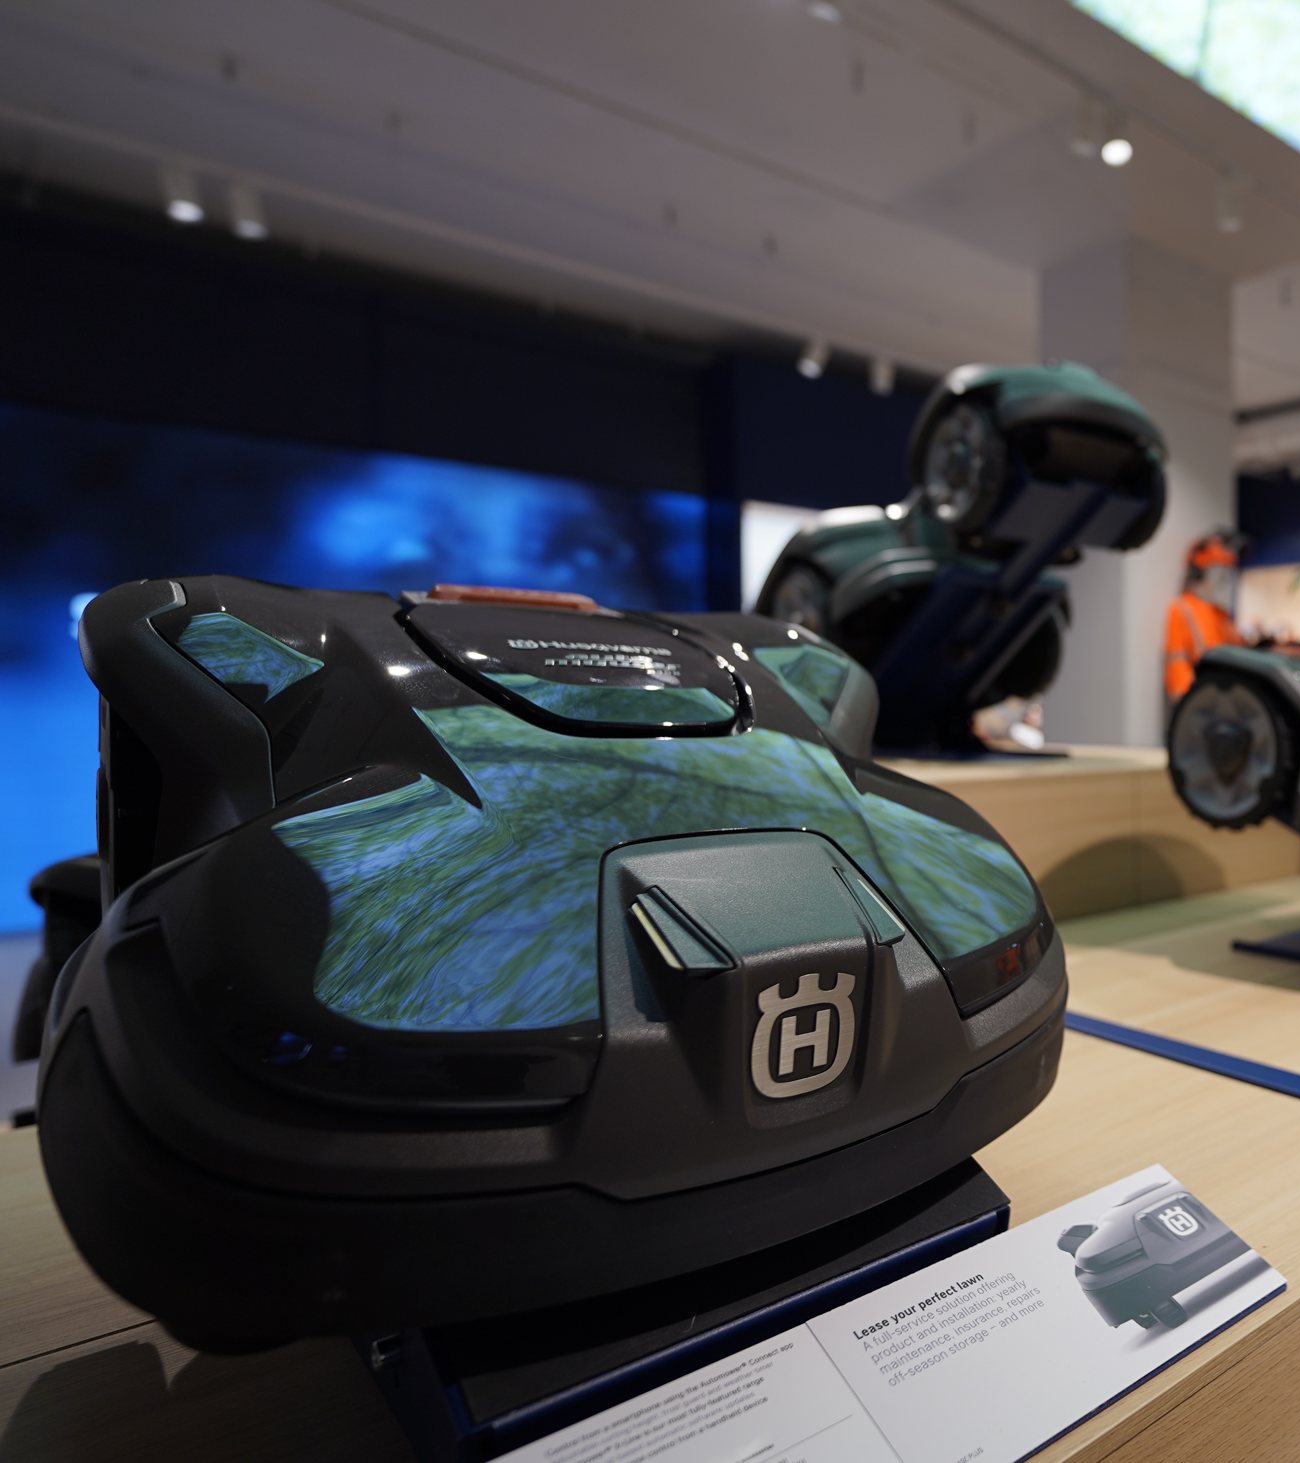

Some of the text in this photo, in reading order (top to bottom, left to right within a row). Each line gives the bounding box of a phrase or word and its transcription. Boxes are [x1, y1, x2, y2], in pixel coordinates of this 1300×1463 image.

[778, 1008, 831, 1076] H
[853, 1273, 984, 1340] Lease your perfect lawn
[863, 1272, 1016, 1351] A full-service solution offering
[871, 1335, 916, 1365] product
[918, 1324, 938, 1341] and
[997, 1280, 1027, 1300] yearly
[1007, 1286, 1041, 1309] repairs
[888, 1351, 949, 1387] off-season
[949, 1328, 990, 1355] storage
[999, 1314, 1019, 1328] and
[1019, 1299, 1045, 1317] more
